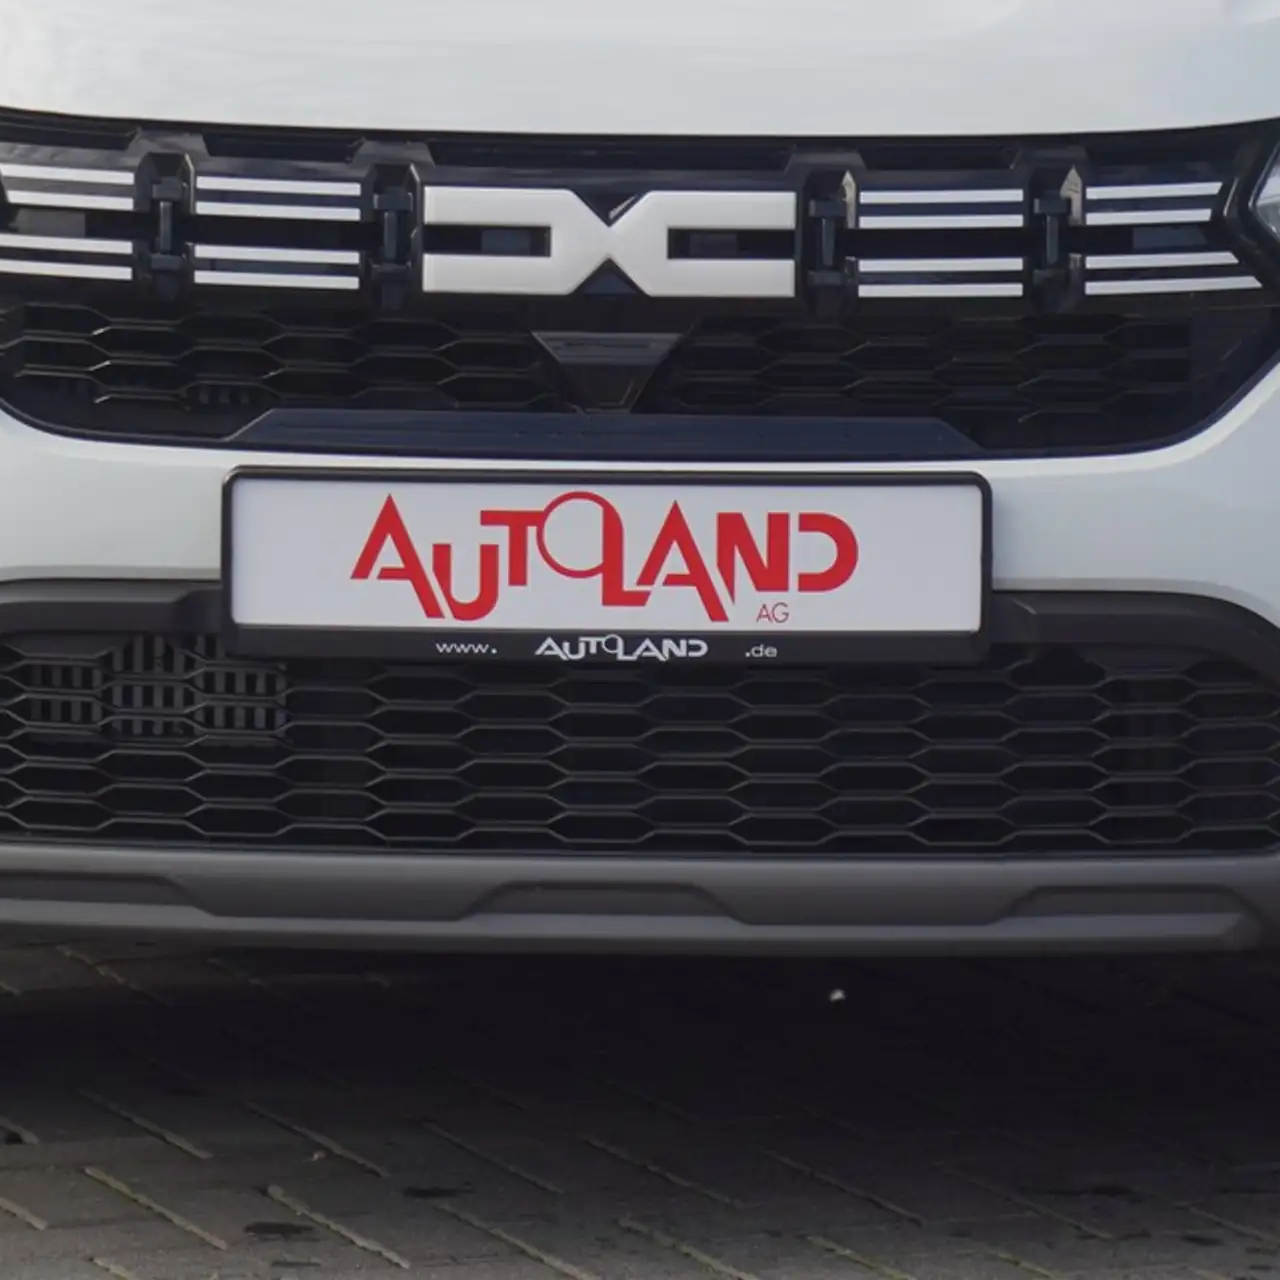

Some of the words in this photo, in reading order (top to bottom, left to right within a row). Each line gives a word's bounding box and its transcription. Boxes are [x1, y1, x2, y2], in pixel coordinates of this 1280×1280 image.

[351, 490, 859, 623] AUTOLAND
[756, 602, 790, 624] AG
[435, 641, 497, 655] www.
[534, 633, 708, 662] AUTOLAND
[745, 643, 778, 658] .de
